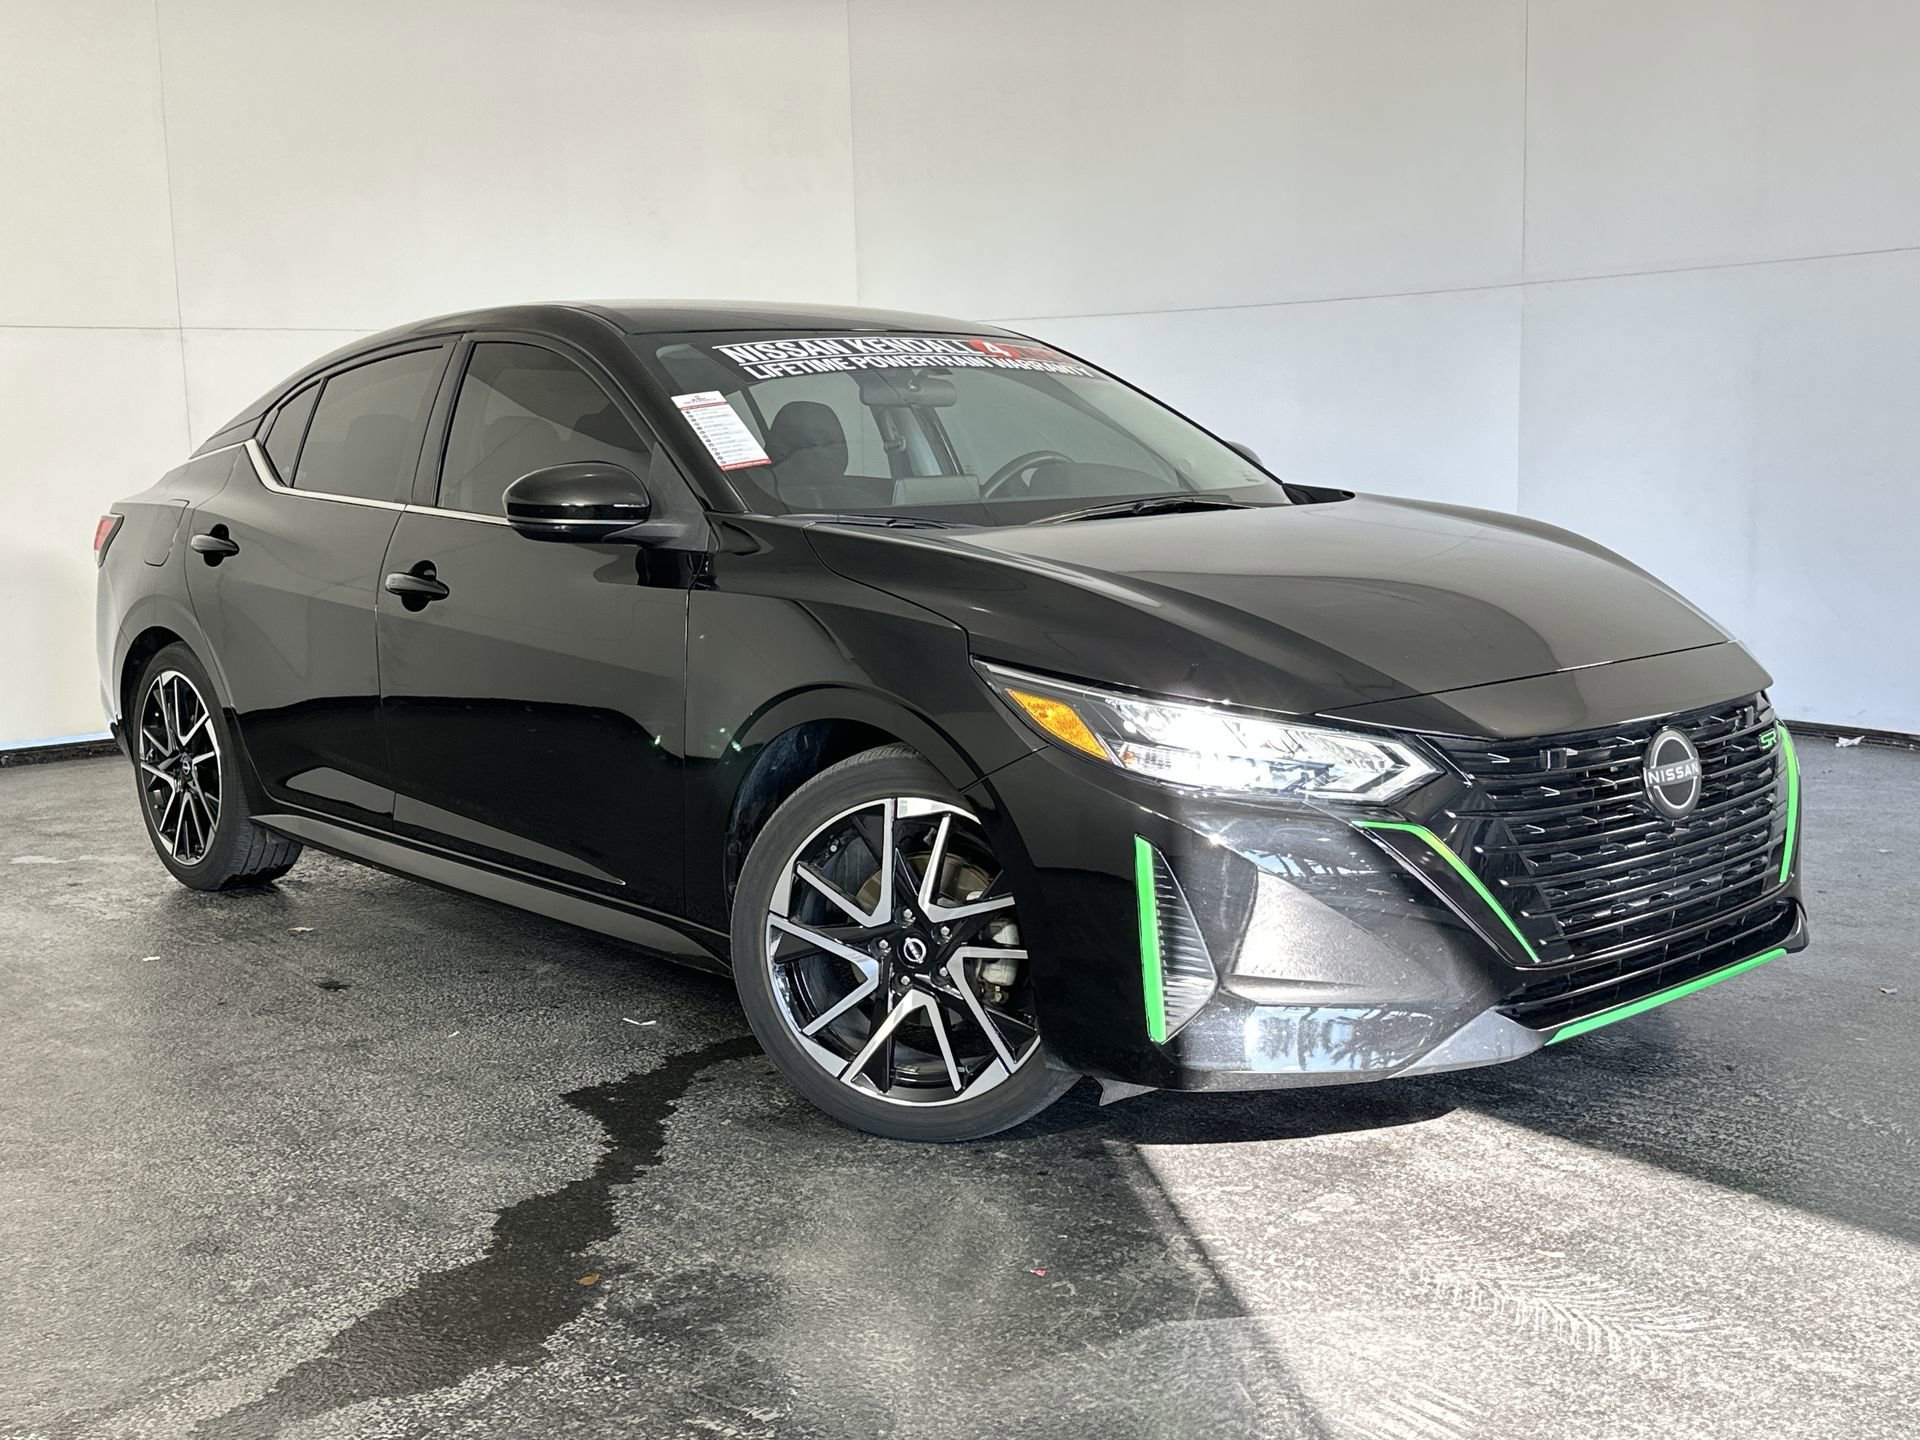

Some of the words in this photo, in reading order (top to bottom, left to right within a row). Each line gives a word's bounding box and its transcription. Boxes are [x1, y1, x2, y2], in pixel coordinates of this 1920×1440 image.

[718, 339, 853, 364] NISSAN
[843, 338, 985, 355] KENDALL
[982, 341, 1013, 357] 4
[743, 357, 857, 380] LIFETIME
[847, 355, 994, 370] POWERTRAIN
[984, 356, 1094, 378] WARRANTY
[1760, 730, 1777, 749] SR
[1649, 761, 1699, 785] NISSAN
